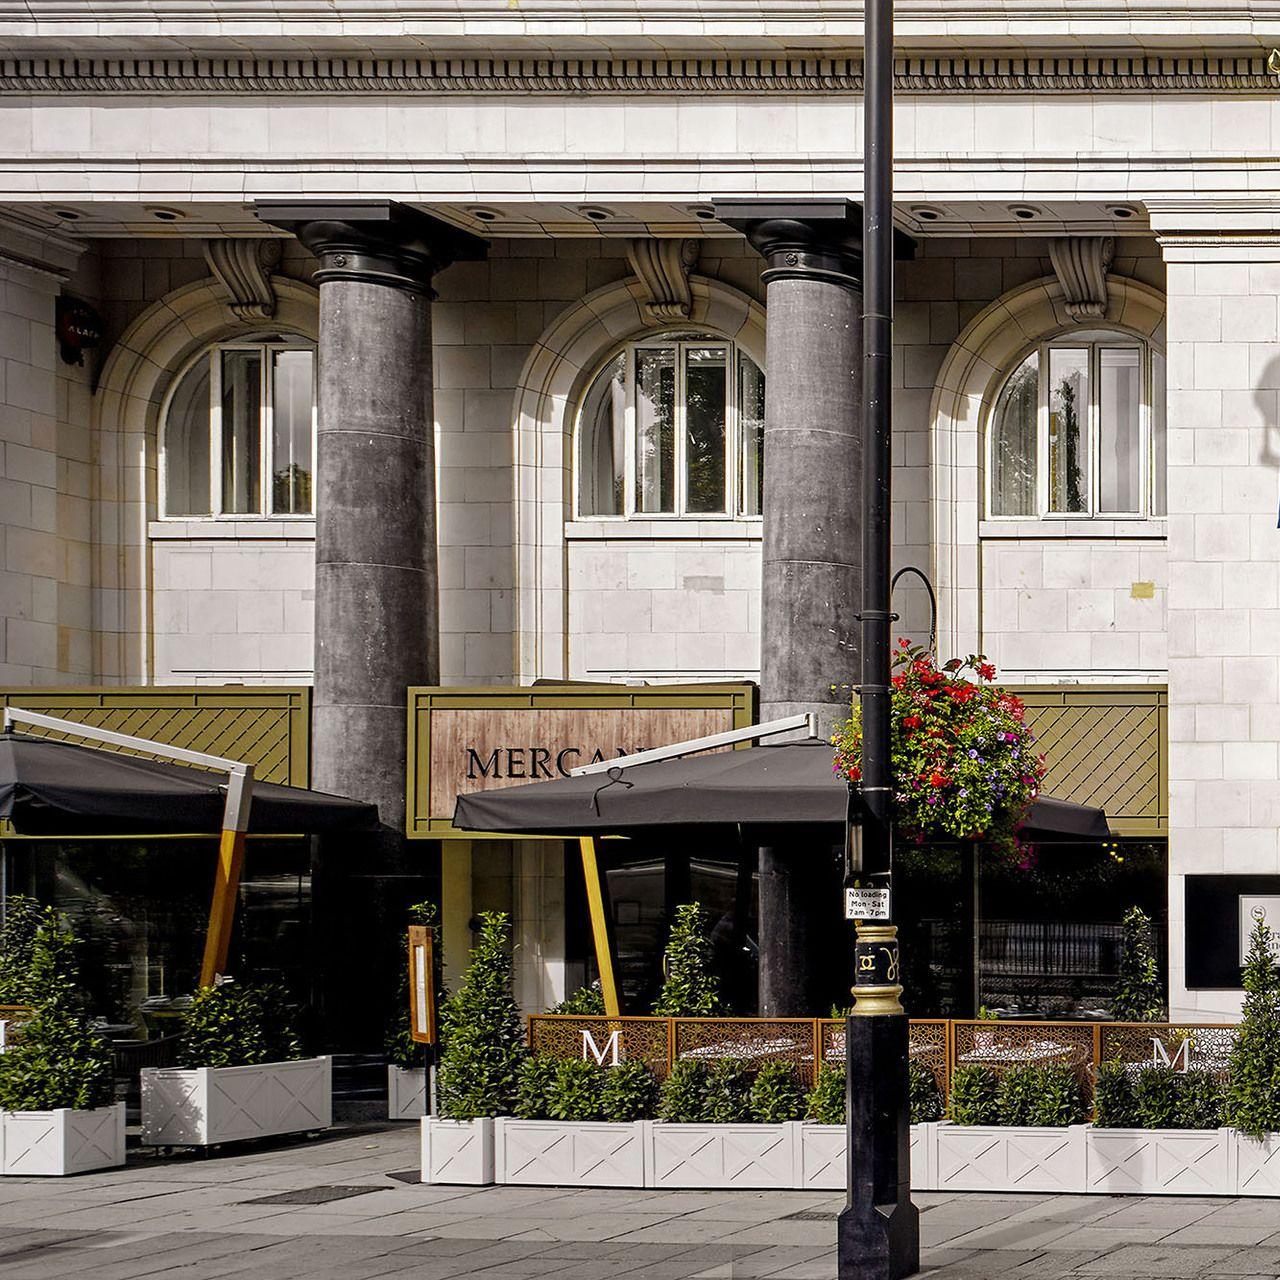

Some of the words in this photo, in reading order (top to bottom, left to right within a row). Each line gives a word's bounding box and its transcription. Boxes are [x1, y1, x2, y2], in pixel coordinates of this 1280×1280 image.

[861, 890, 887, 899] loading
[579, 1030, 622, 1066] M
[1150, 1037, 1191, 1073] M
